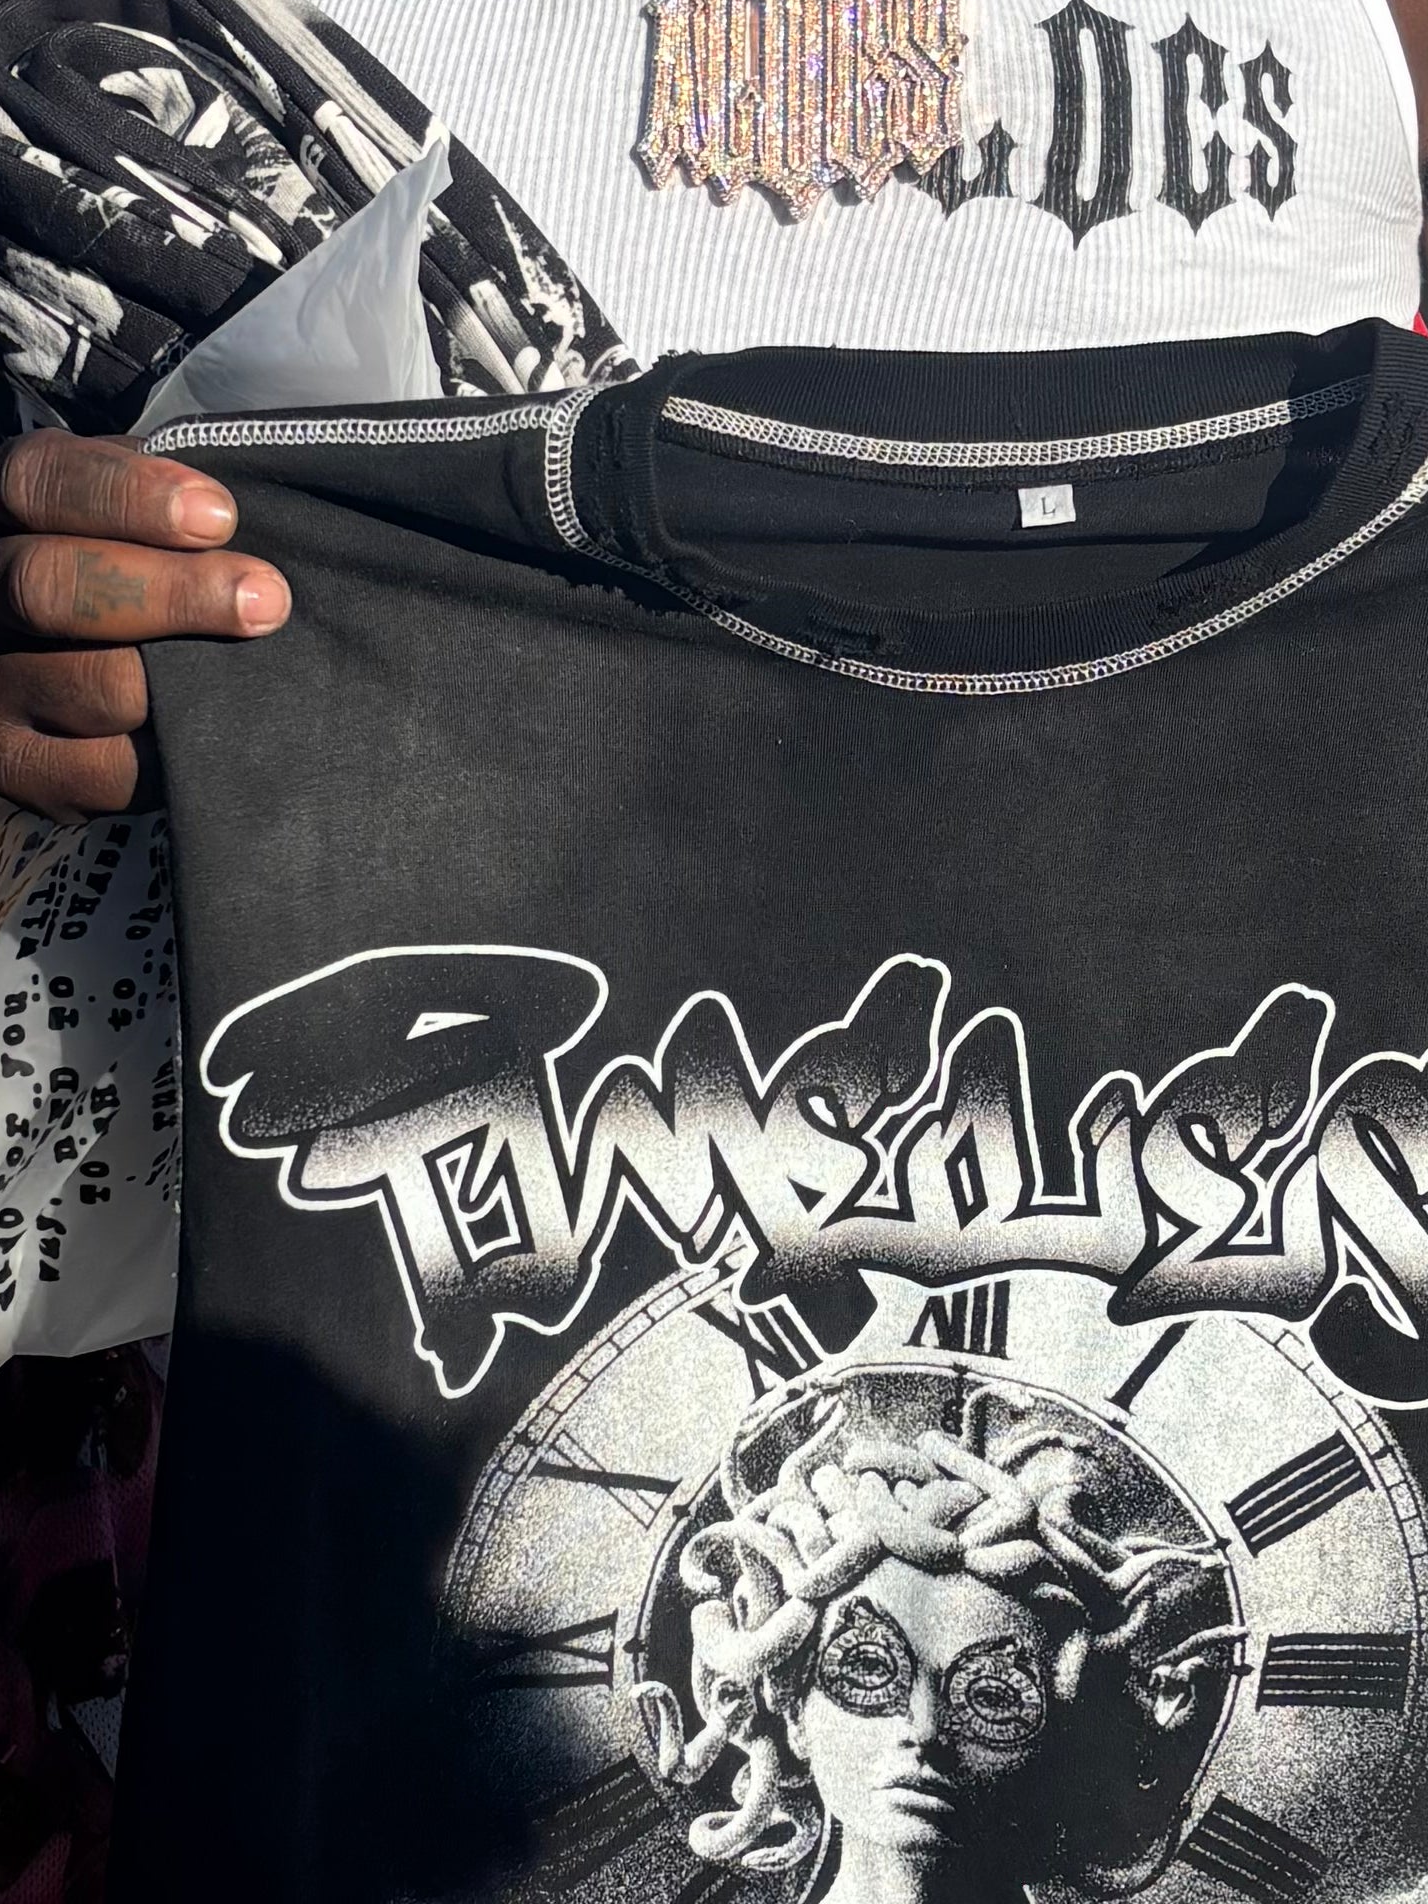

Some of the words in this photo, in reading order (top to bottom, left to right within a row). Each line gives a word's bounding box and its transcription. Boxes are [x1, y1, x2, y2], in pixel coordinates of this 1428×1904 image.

[1041, 496, 1056, 515] L
[47, 975, 80, 1031] TO
[0, 990, 35, 1079] you
